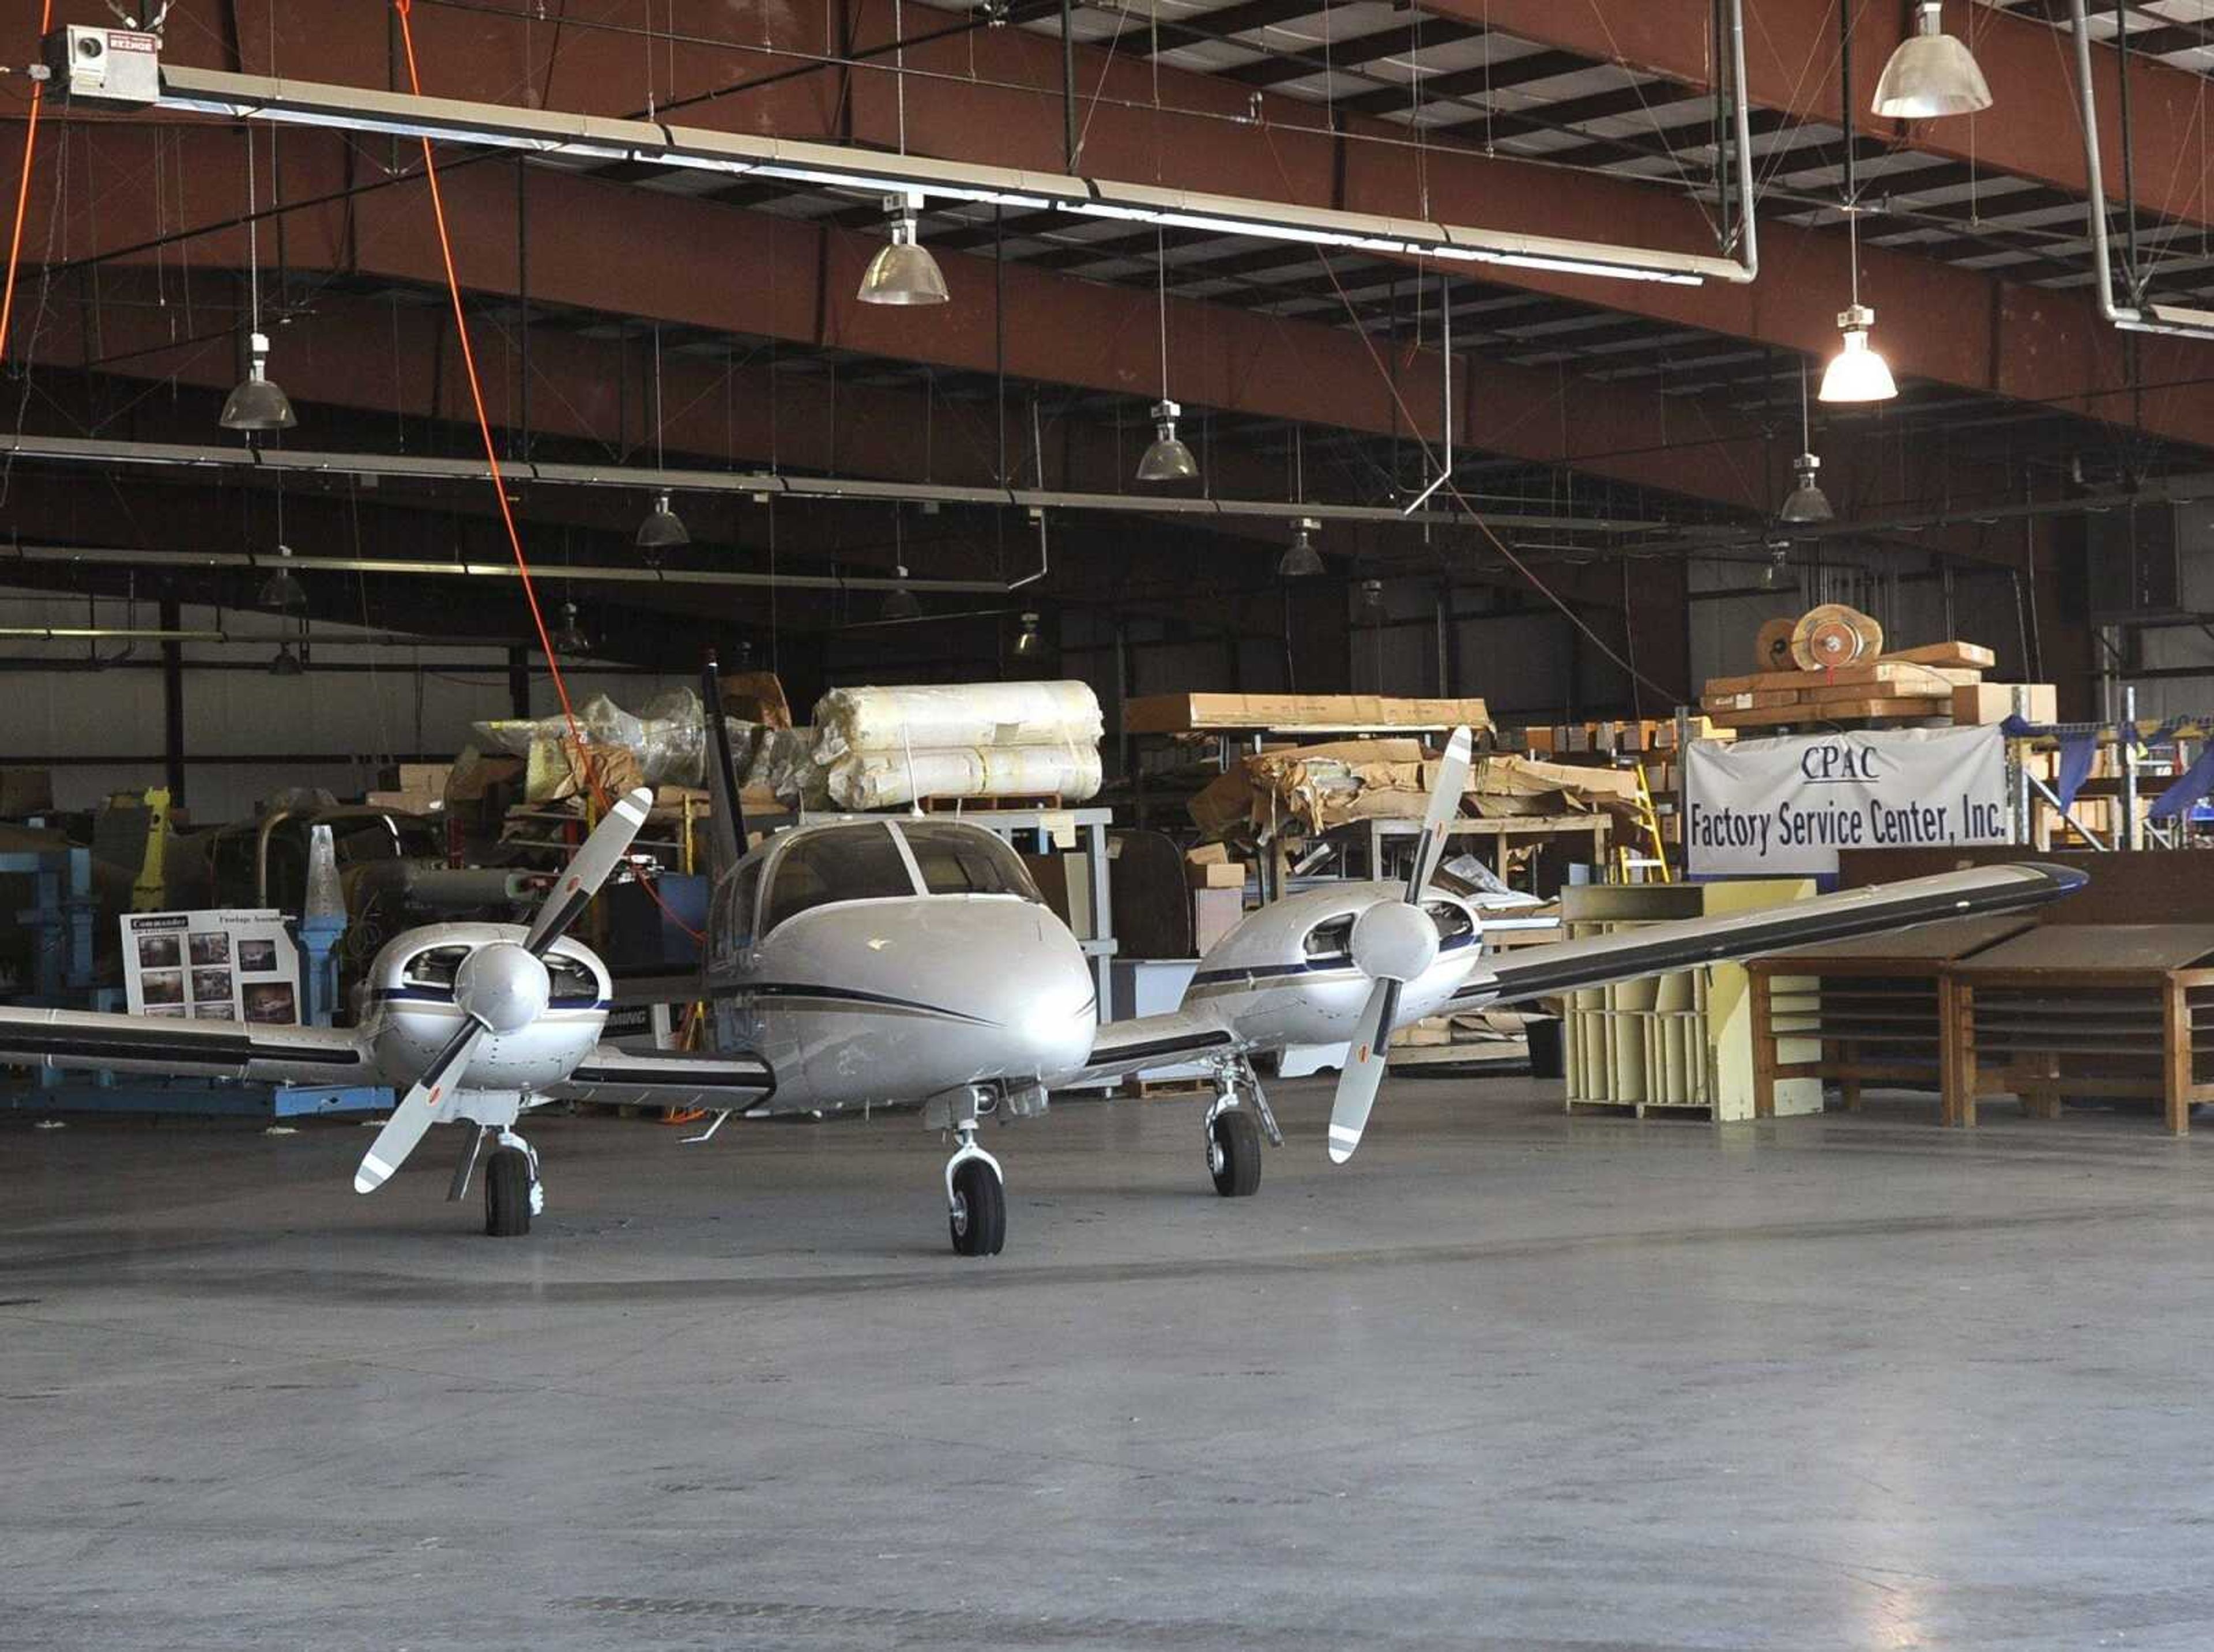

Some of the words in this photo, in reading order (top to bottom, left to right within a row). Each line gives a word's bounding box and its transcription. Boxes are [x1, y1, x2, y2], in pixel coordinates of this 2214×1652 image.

[1801, 745, 1880, 779] CPAC
[1691, 804, 1771, 856] Factory
[1779, 799, 1862, 845] Service
[1870, 798, 1955, 845] Center,
[1963, 793, 2006, 839] Inc.
